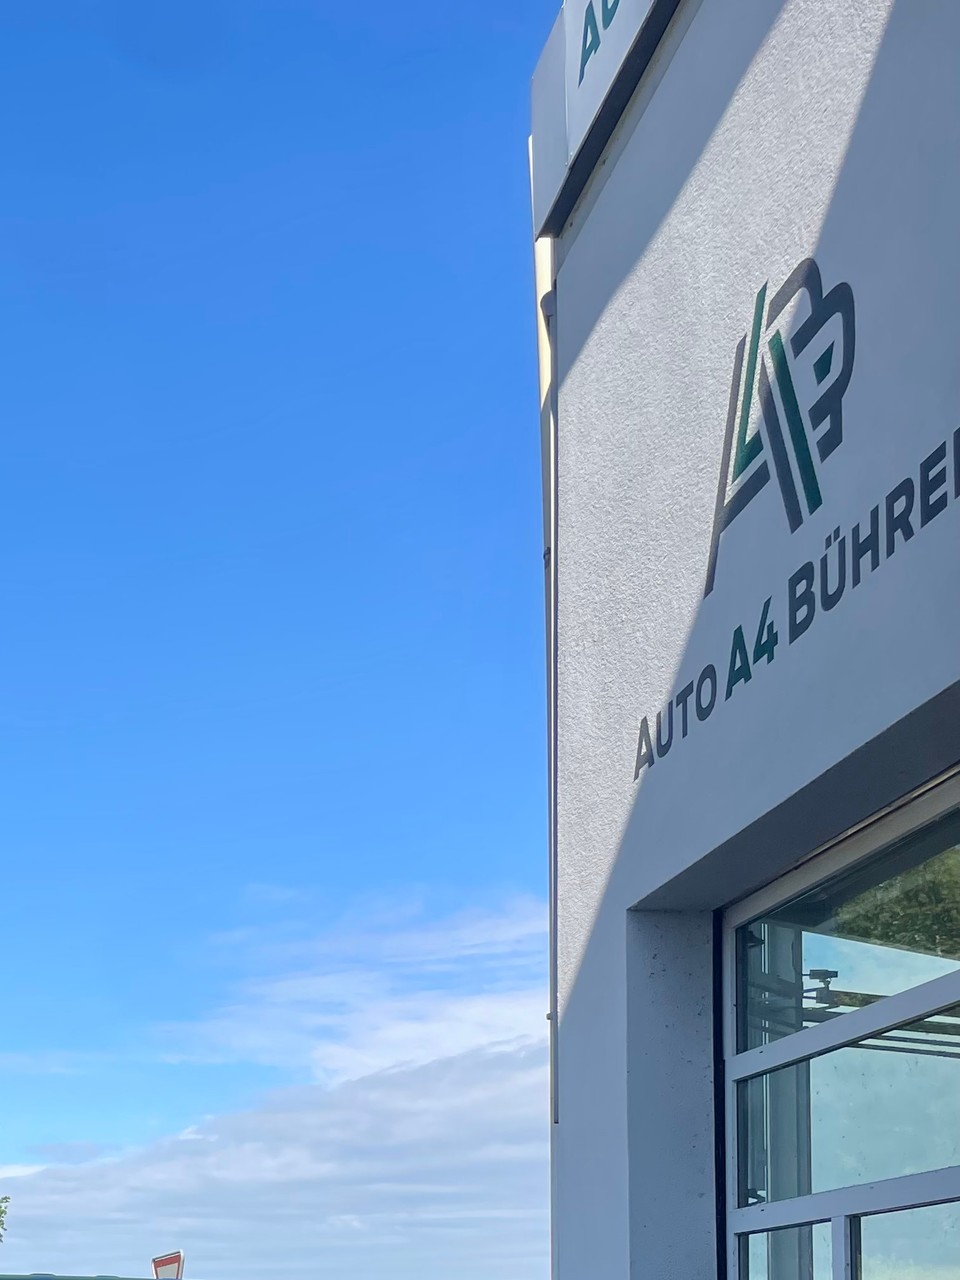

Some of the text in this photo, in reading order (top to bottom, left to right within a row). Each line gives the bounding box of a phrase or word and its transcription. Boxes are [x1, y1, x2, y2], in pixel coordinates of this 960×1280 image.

[633, 424, 960, 783] AUTO A4 BÜHRE
